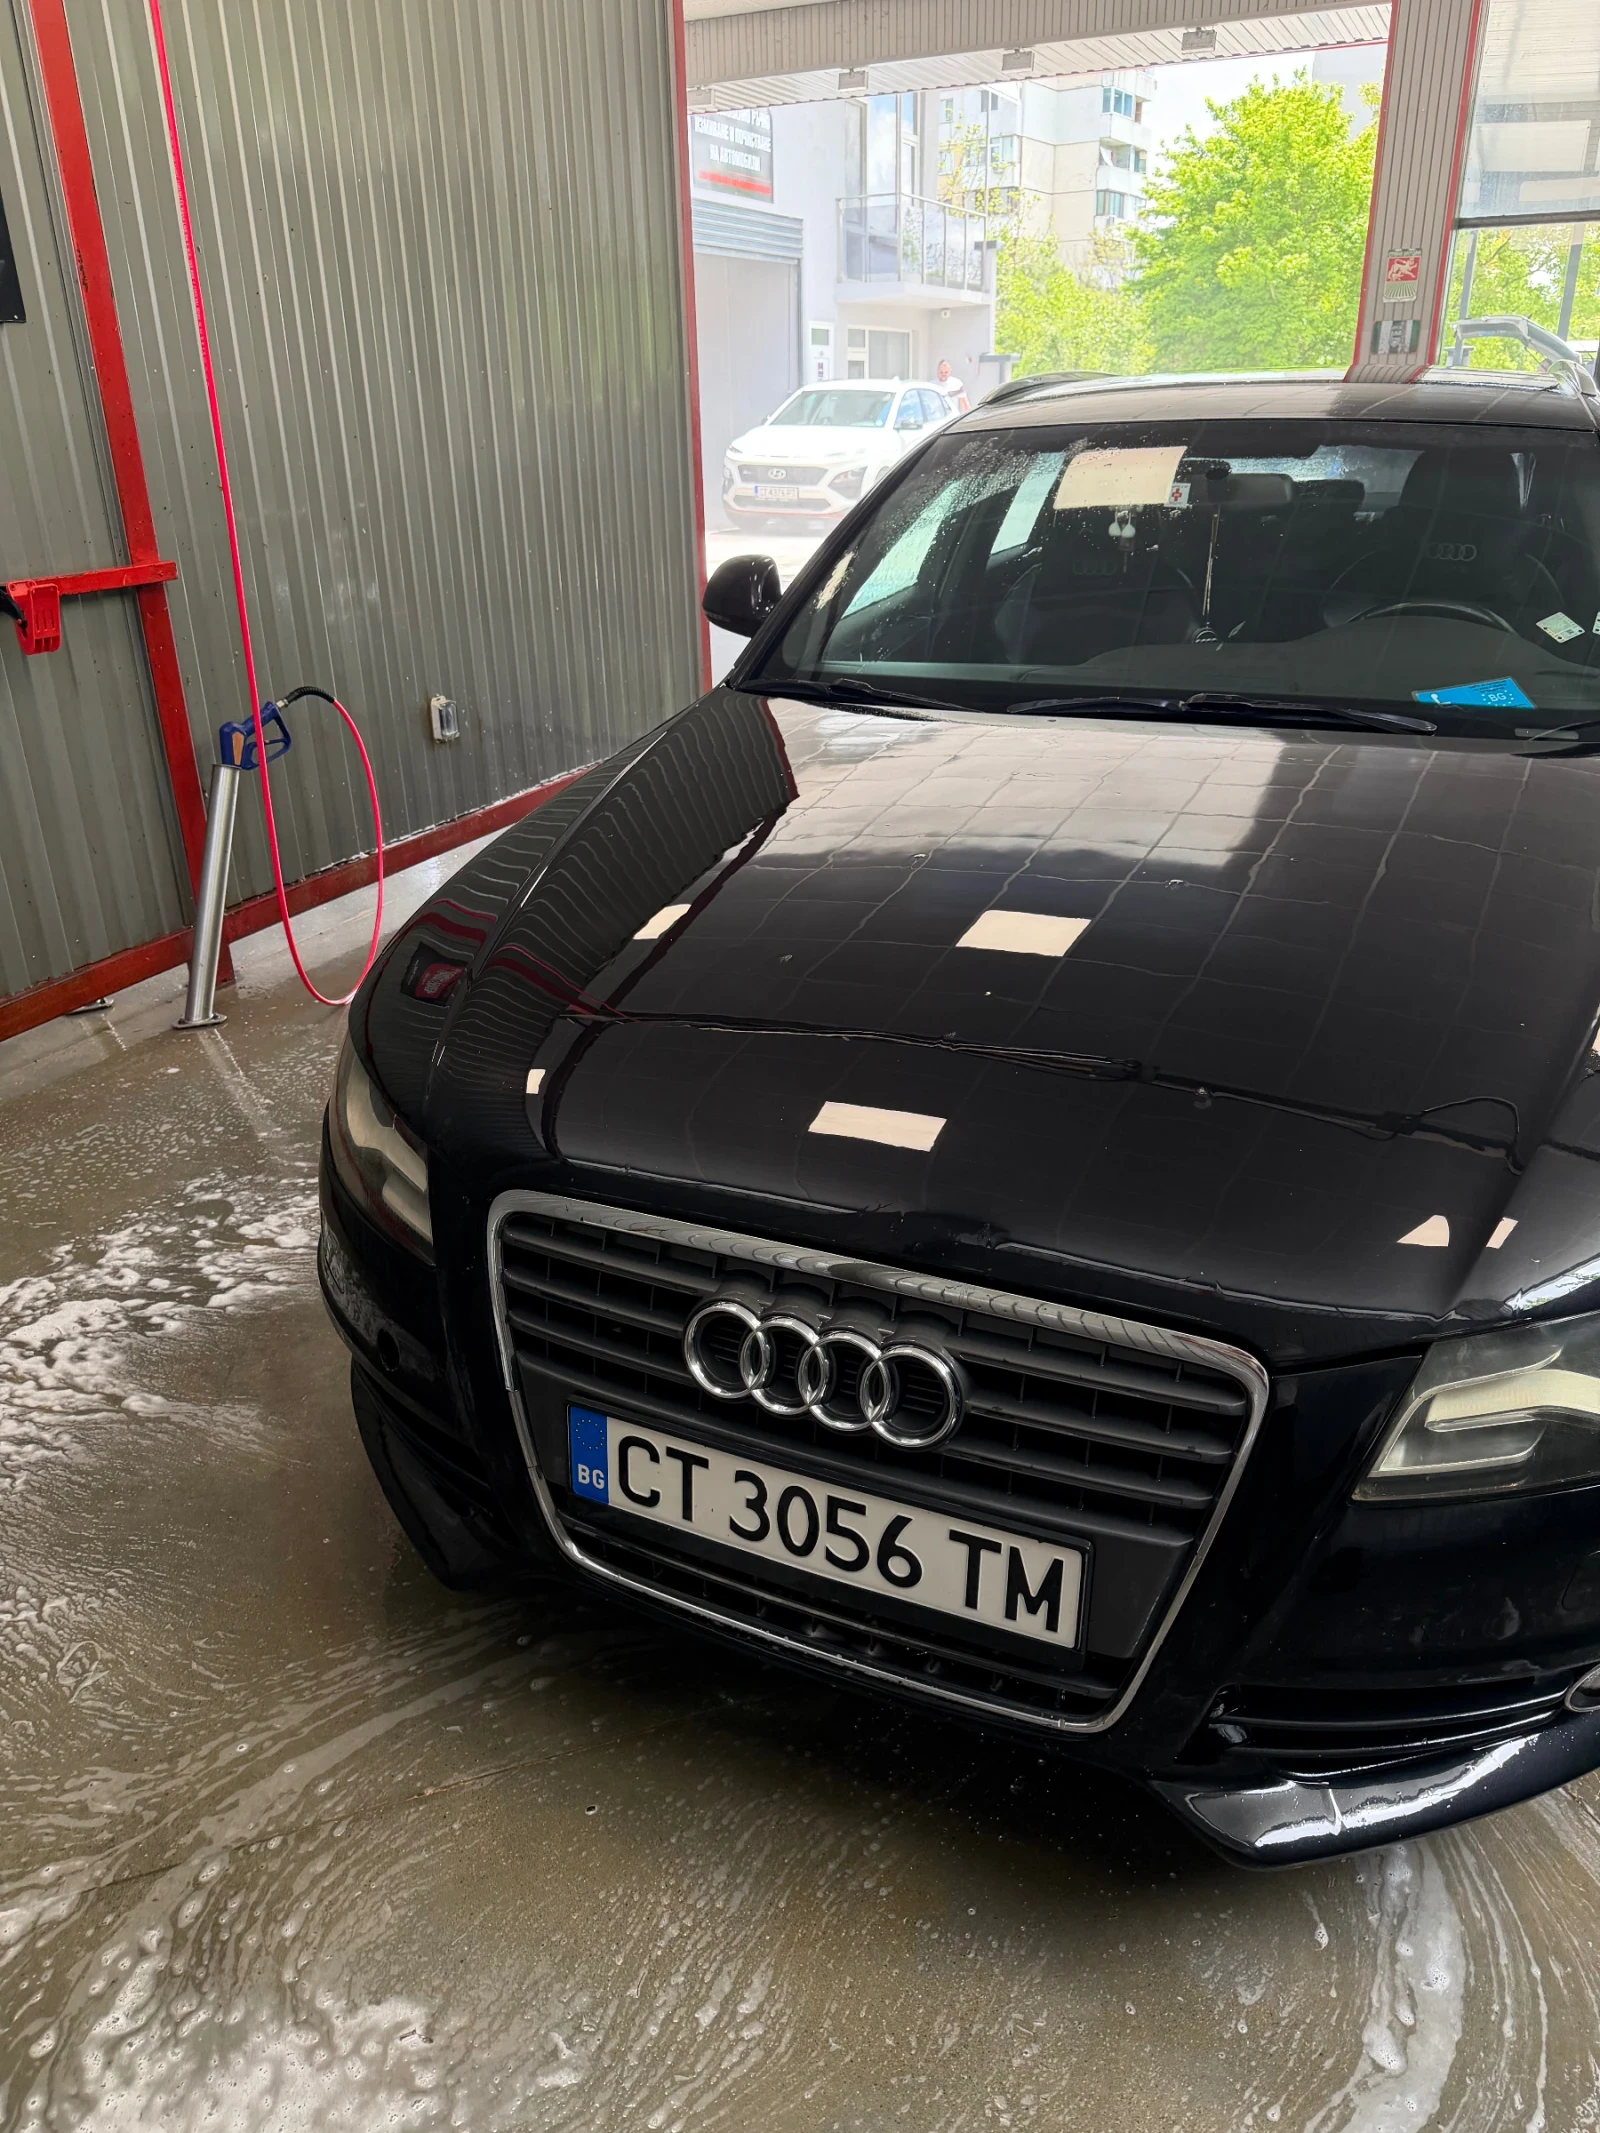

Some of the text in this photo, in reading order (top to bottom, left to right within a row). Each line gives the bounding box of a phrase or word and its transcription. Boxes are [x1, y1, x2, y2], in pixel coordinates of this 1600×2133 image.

[1487, 692, 1507, 702] BG
[577, 1463, 605, 1490] BG
[618, 1435, 1064, 1633] CT 3056 TM
